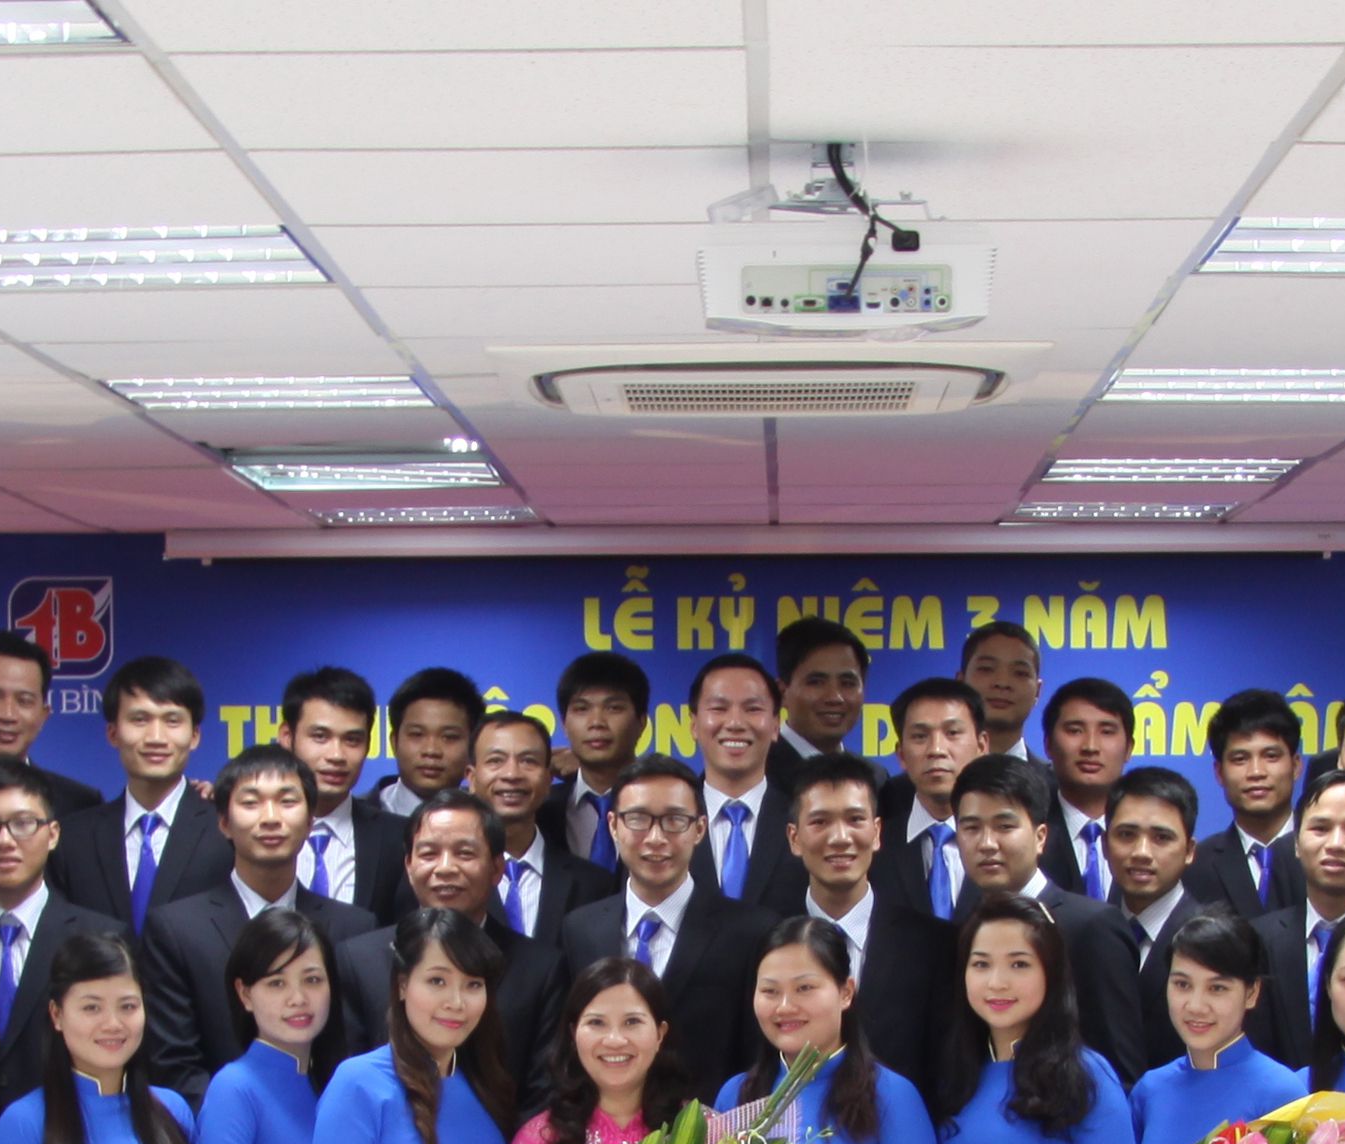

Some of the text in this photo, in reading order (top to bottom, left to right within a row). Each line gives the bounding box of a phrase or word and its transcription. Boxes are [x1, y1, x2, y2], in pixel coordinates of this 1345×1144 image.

[583, 565, 654, 651] LỄ
[676, 572, 755, 650] KỶ
[1023, 580, 1168, 650] NĂM
